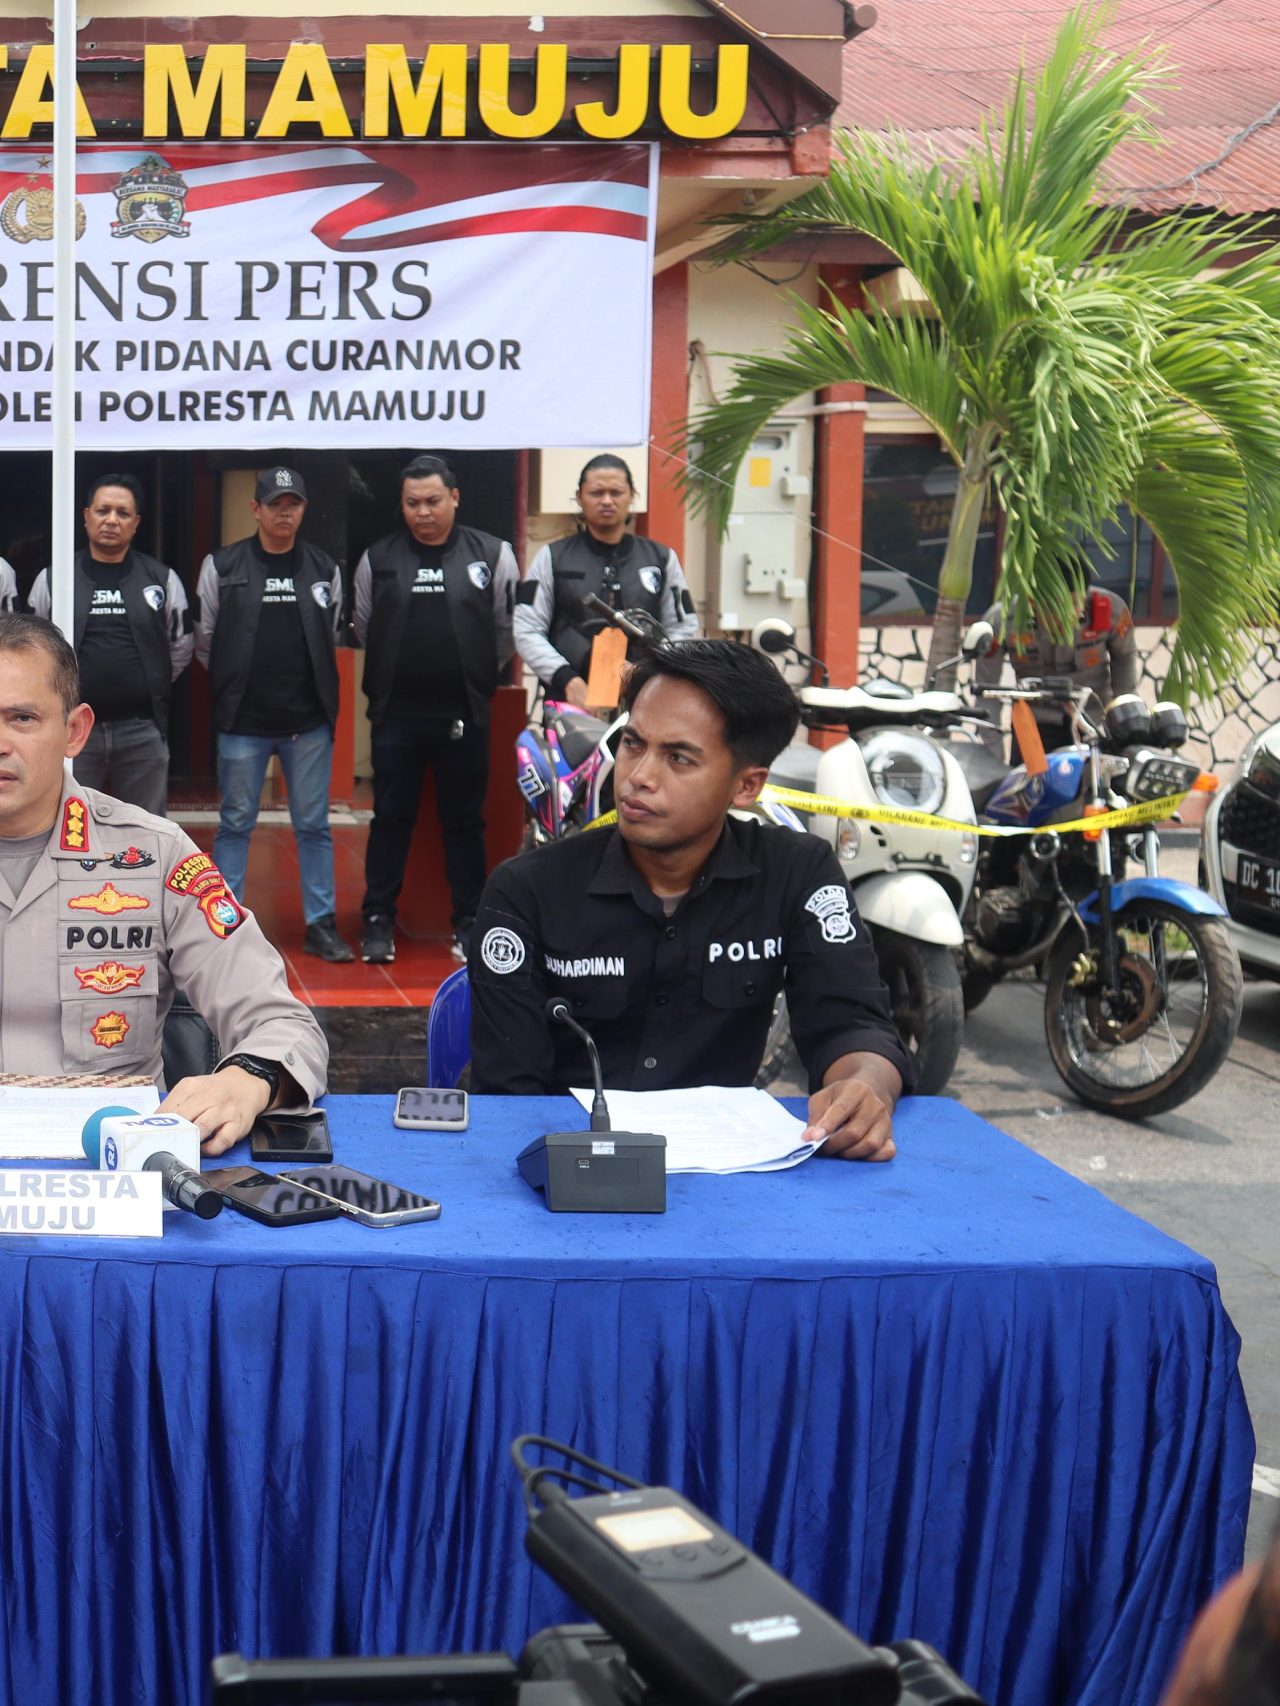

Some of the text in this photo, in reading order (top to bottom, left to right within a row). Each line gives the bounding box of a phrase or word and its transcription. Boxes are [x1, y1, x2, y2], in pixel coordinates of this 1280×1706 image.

[142, 43, 749, 140] MAMUJU
[236, 259, 432, 322] PERS
[117, 339, 272, 373] PIDANA
[286, 338, 521, 371] CURANMOR
[99, 390, 294, 422] POLRESTA
[308, 389, 486, 421] MAMUJU
[1242, 861, 1259, 889] DC
[66, 926, 153, 950] POLRI
[709, 936, 783, 963] POLRI
